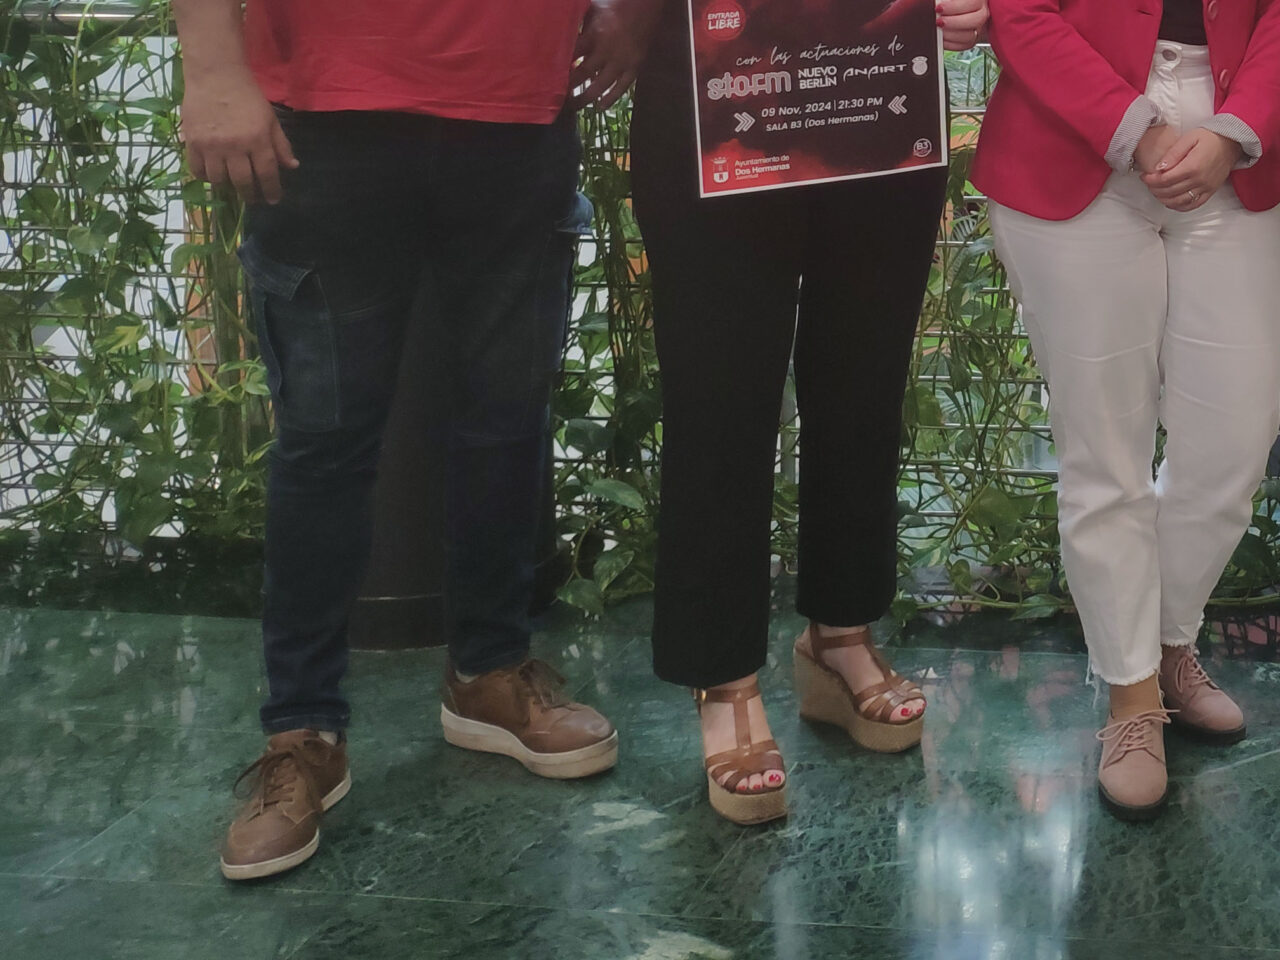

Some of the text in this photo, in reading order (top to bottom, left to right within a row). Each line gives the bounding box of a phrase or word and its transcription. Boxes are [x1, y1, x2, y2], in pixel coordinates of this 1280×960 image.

[707, 10, 740, 20] ENTRADA
[708, 18, 741, 30] LIBRE
[736, 35, 905, 66] con las actuaciones de
[798, 66, 838, 78] NUEVO
[761, 107, 776, 118] 09
[805, 102, 832, 113] 2024
[838, 98, 864, 110] 21:30
[867, 97, 883, 107] PM
[766, 111, 879, 132] SALA B3 (Dos Hermanas)
[735, 156, 780, 168] Ayuntamiento
[735, 163, 790, 176] Dos Hermanas
